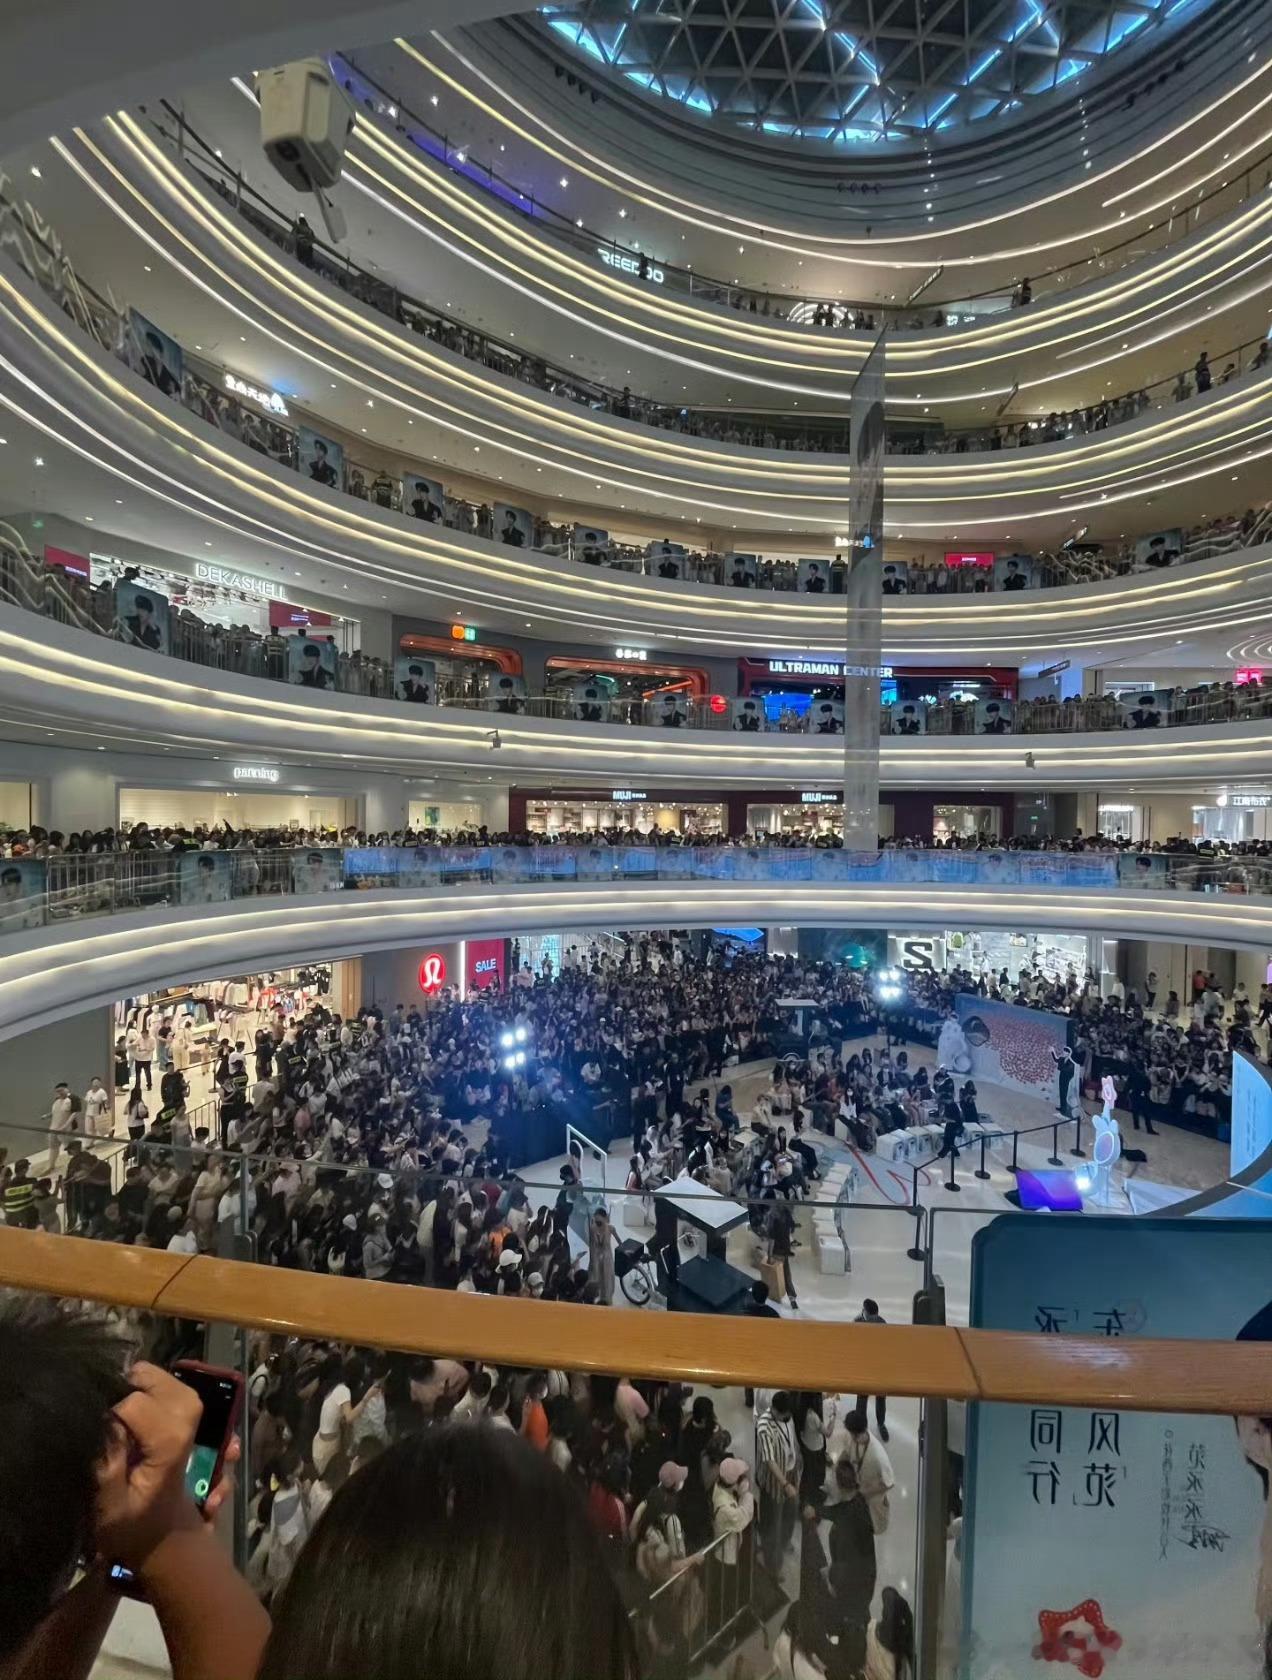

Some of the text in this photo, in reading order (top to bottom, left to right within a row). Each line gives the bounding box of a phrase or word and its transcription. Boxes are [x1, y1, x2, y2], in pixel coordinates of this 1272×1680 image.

[195, 563, 288, 601] DEKASHELL
[769, 661, 893, 678] ULTRAMAN CENTER
[612, 790, 632, 800] MUJI
[801, 792, 822, 802] MUJI
[475, 958, 497, 973] SALE
